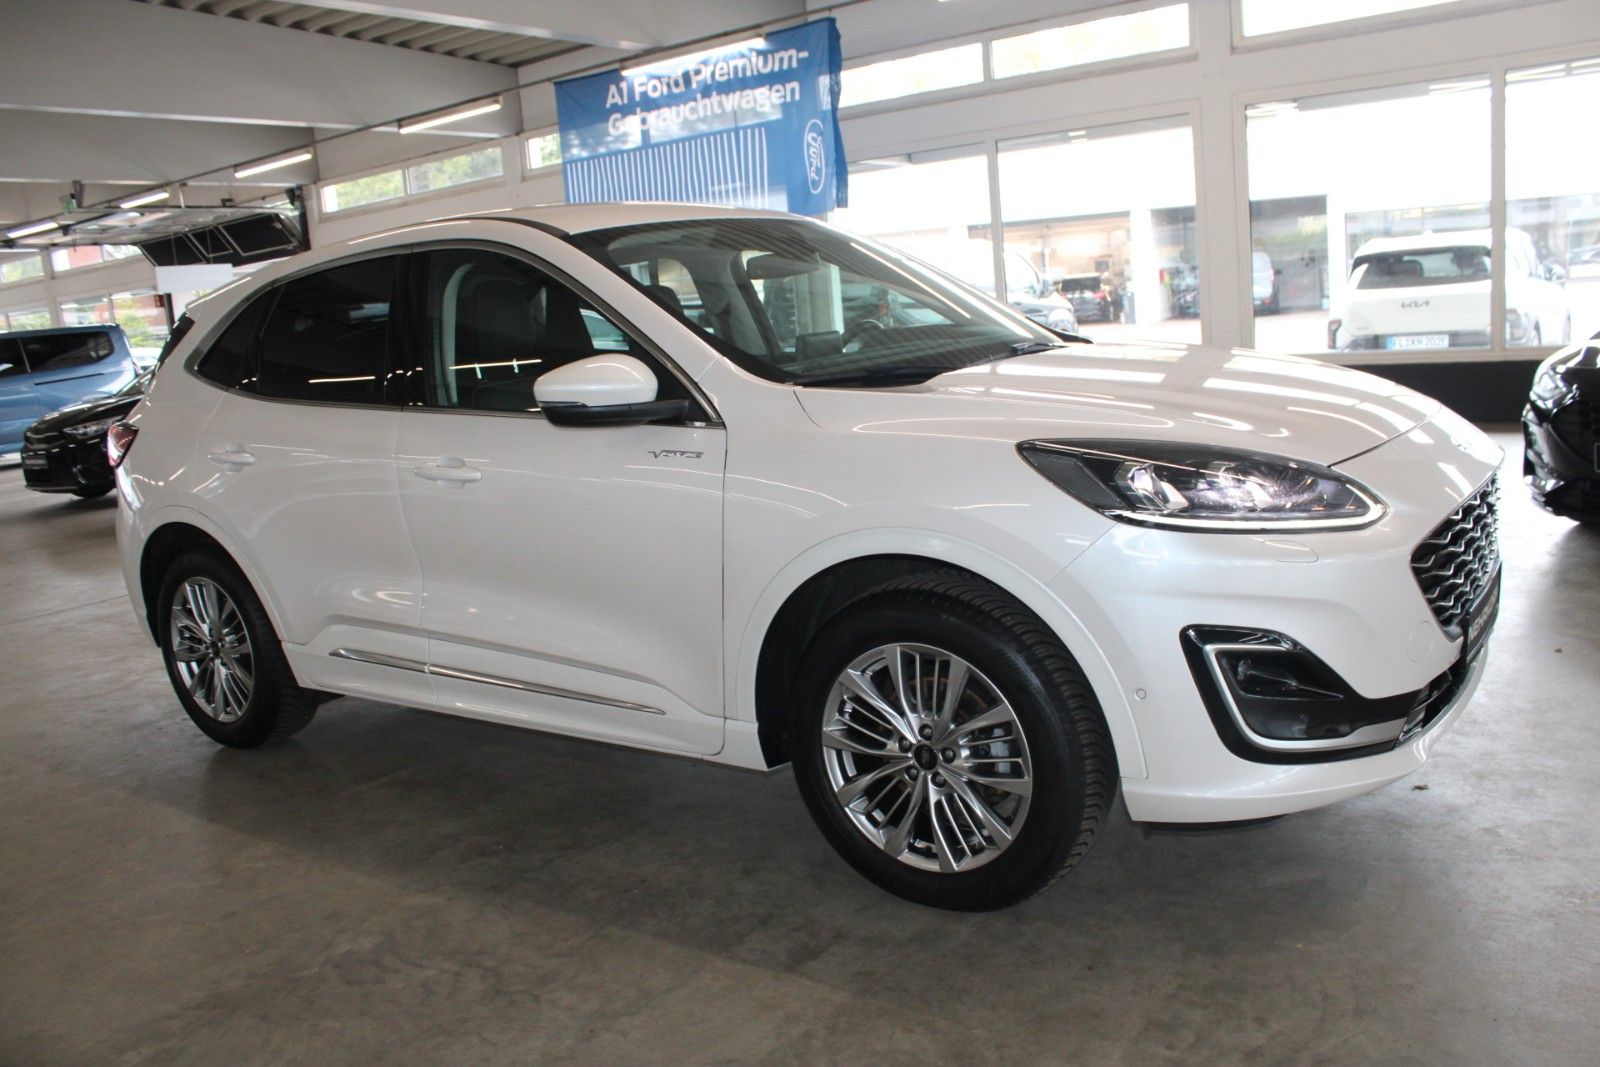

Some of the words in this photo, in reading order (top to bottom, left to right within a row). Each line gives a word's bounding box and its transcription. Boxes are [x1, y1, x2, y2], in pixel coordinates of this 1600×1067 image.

[634, 69, 686, 100] Ford
[688, 48, 809, 89] Premium-
[608, 81, 800, 136] Gebrauchtwagen
[807, 132, 822, 181] Ford
